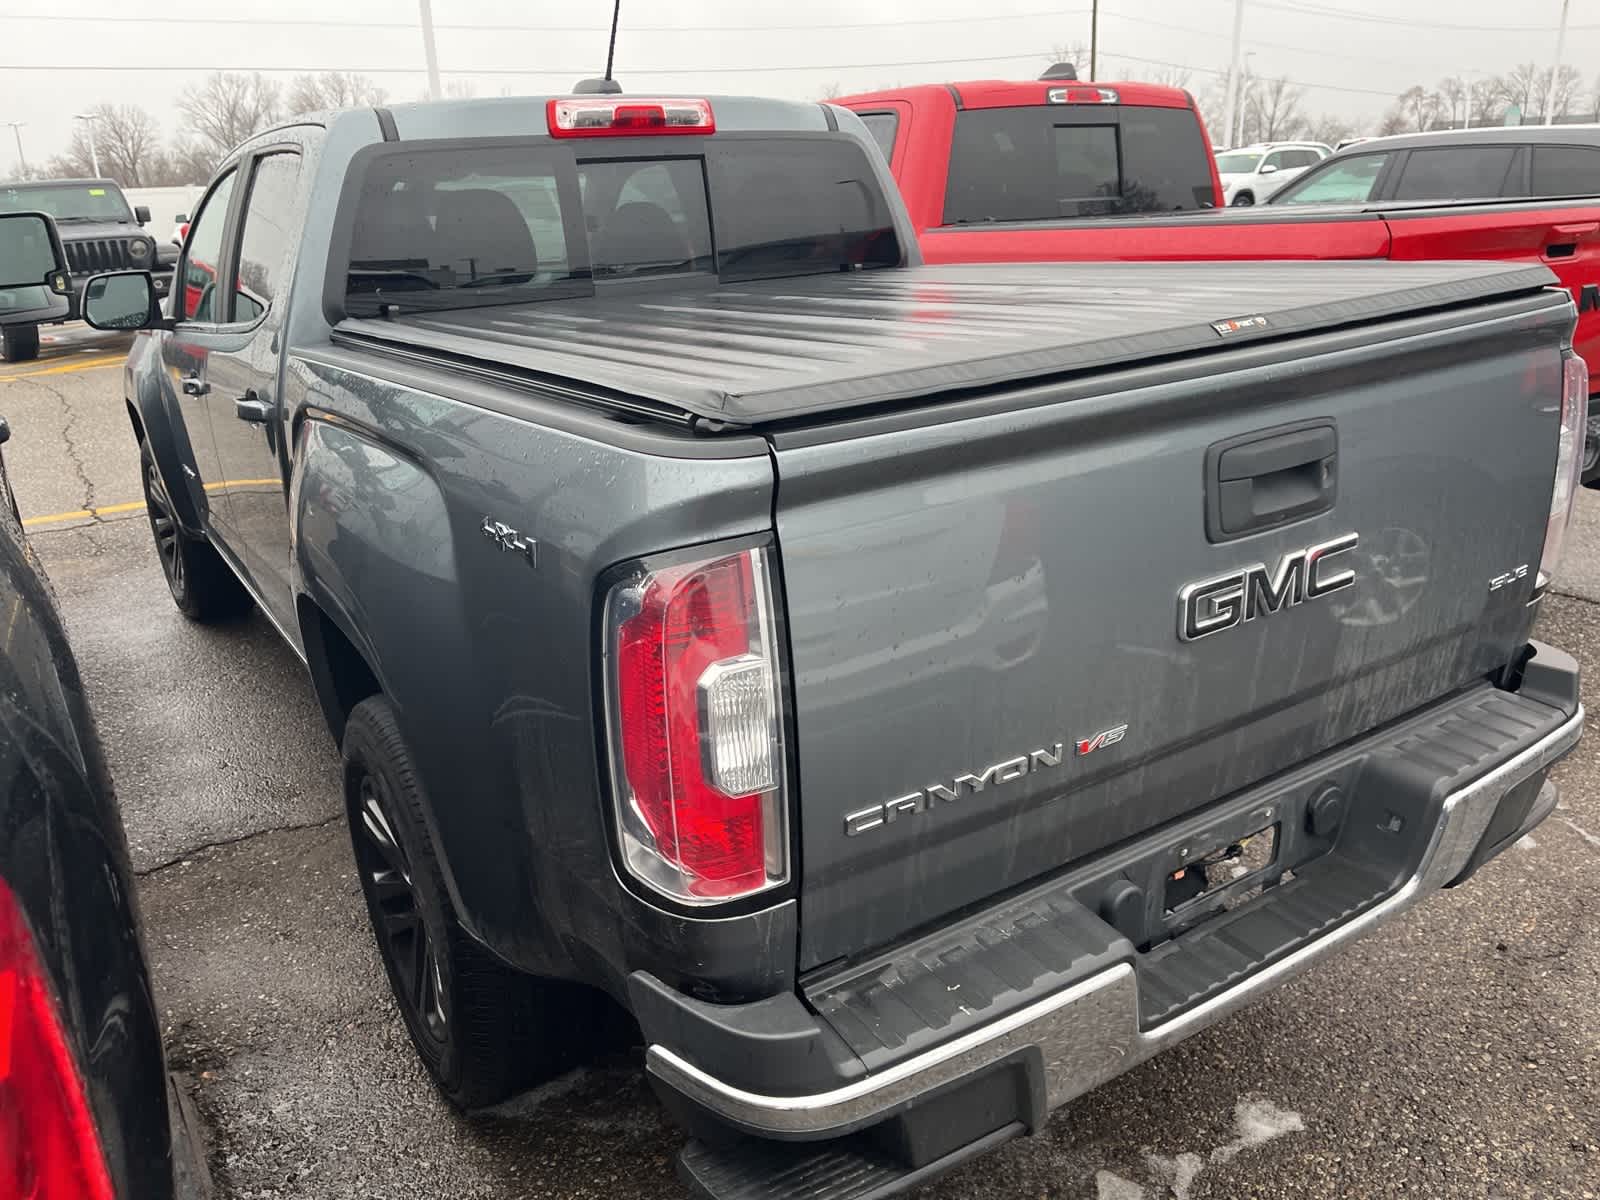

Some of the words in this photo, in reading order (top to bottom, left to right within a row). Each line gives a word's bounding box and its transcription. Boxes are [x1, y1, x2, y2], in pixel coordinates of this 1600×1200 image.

[1177, 532, 1360, 642] GMC
[844, 743, 1063, 836] CANYON
[1075, 724, 1128, 756] V6
